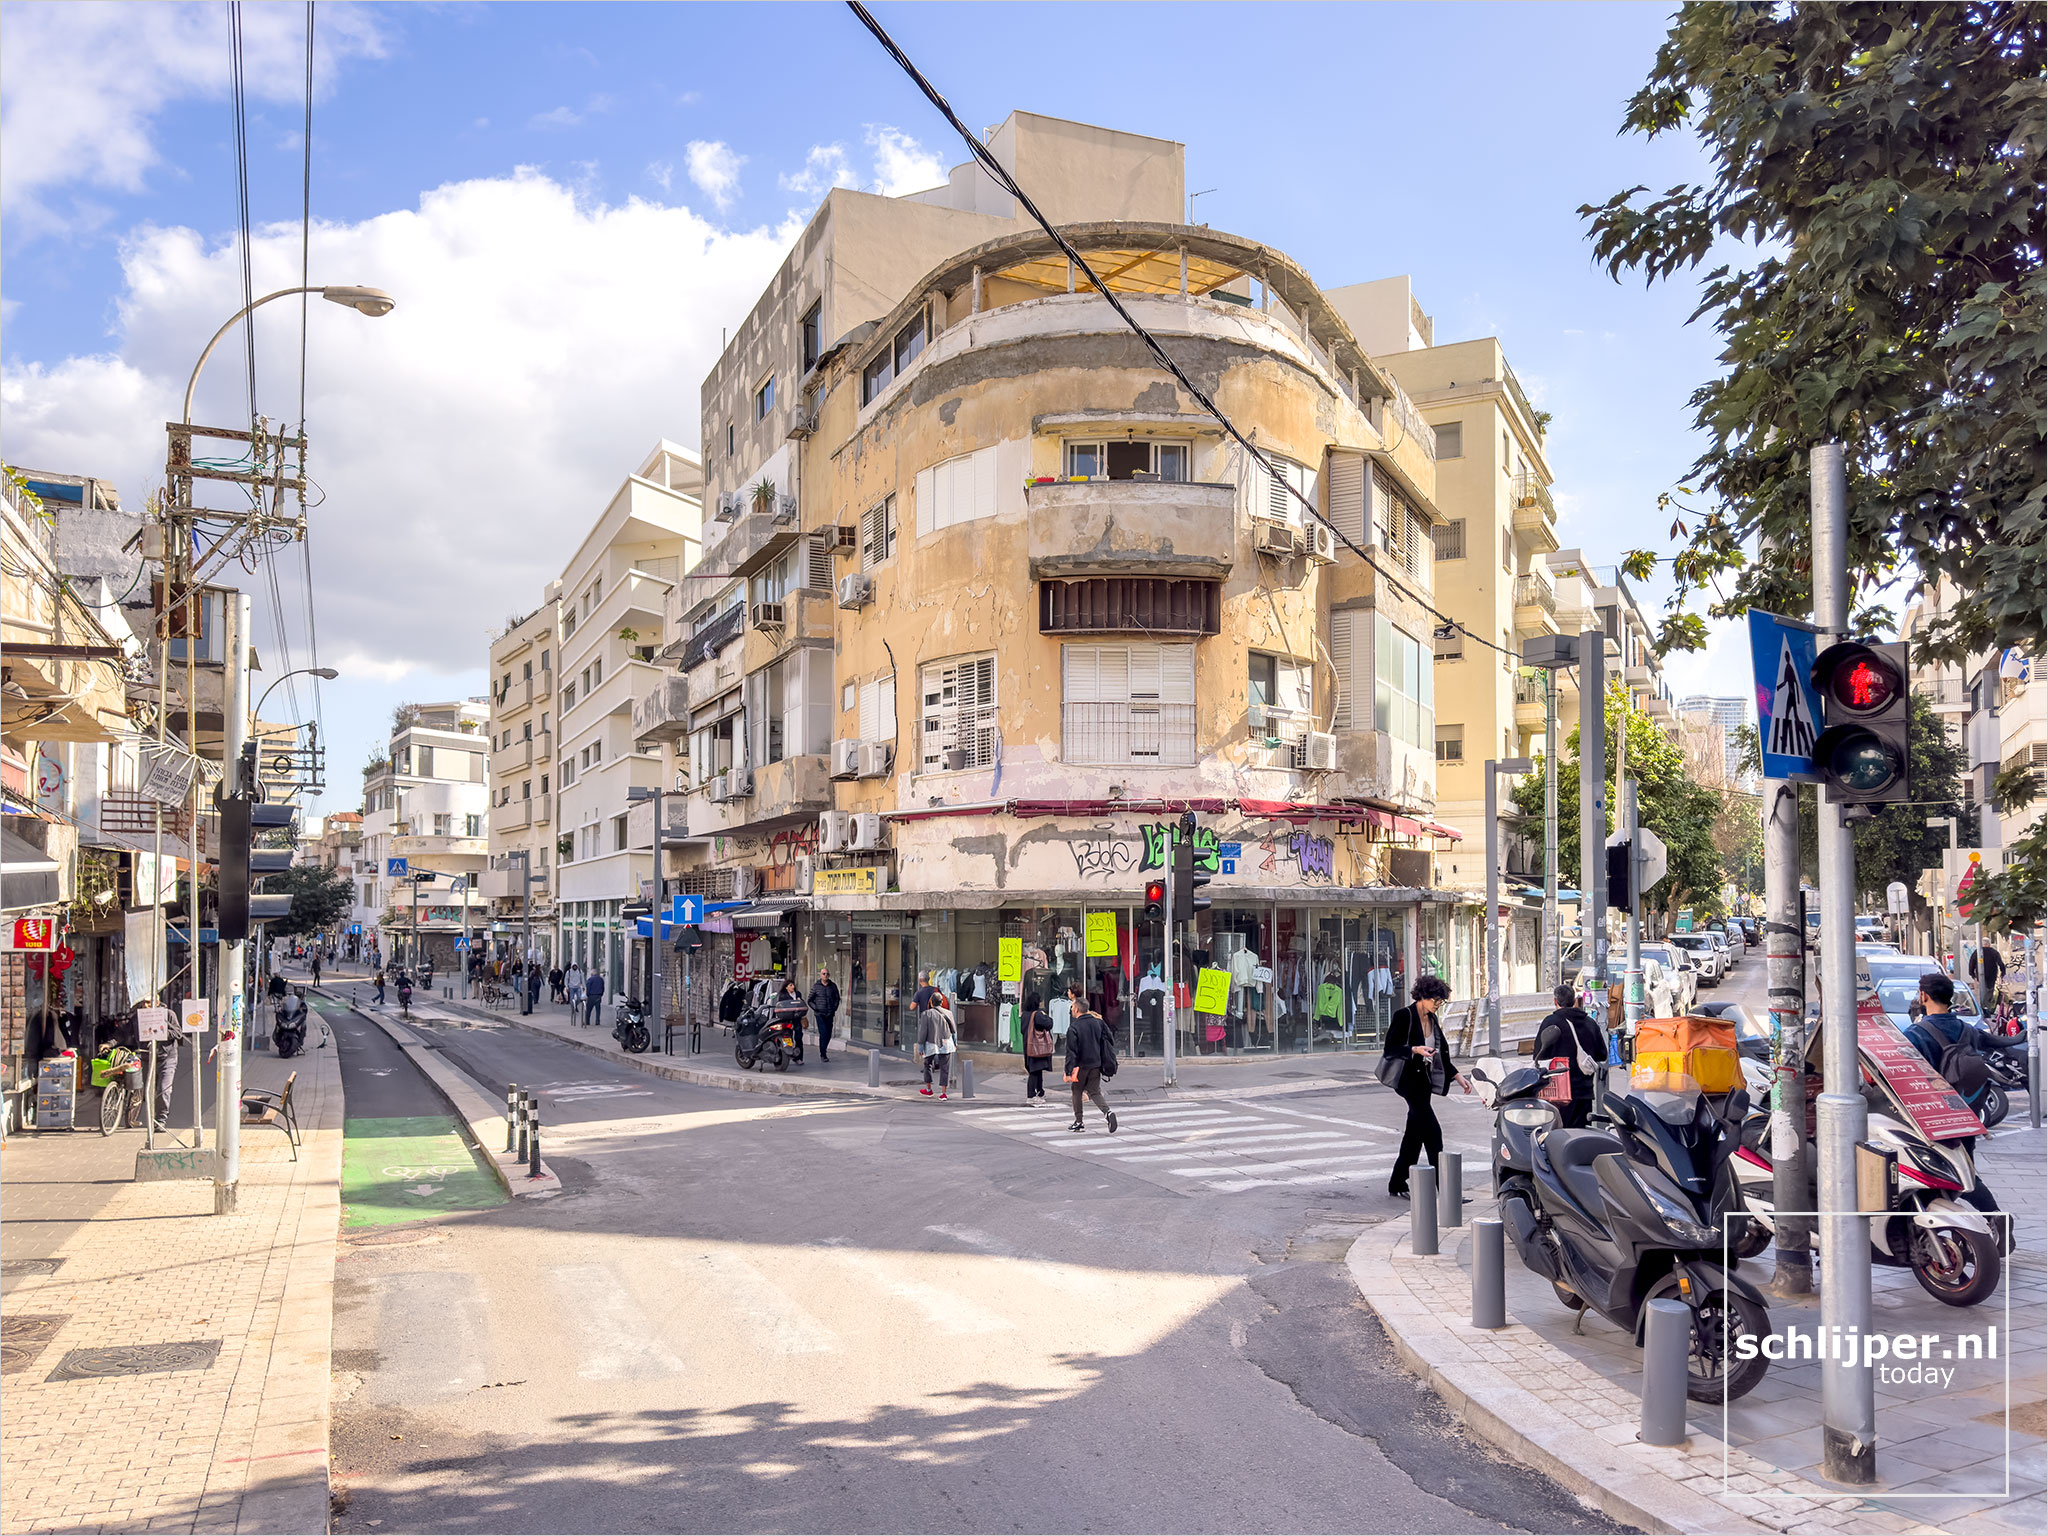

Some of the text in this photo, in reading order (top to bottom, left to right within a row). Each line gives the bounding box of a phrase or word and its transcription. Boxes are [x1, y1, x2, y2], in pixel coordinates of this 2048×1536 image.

[1226, 862, 1231, 872] 1
[1090, 928, 1110, 953] 5
[736, 962, 754, 979] 99
[1003, 955, 1015, 977] 5
[1199, 985, 1217, 1010] 5
